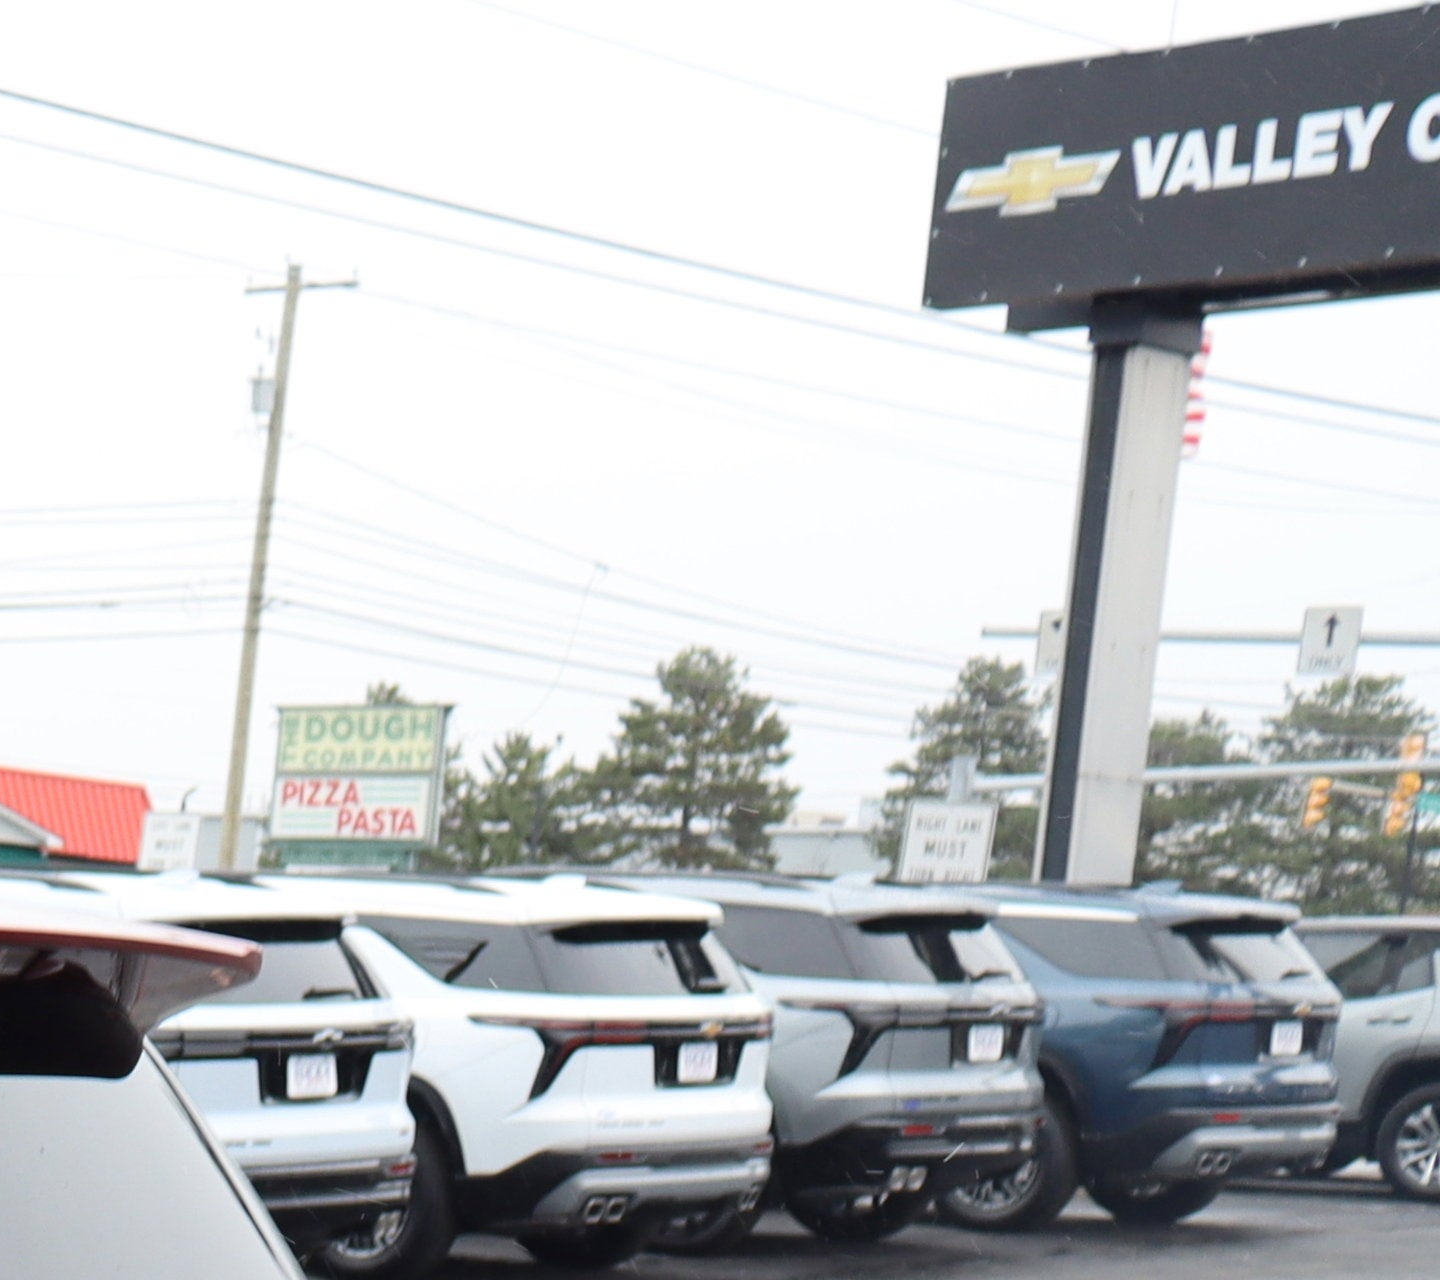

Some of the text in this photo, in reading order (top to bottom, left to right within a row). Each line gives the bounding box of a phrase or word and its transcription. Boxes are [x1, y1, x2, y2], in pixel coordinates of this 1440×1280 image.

[1131, 101, 1394, 200] VALLEY
[305, 714, 433, 743] DOUGH
[304, 748, 432, 768] COMPANY
[282, 779, 361, 807] PIZZA
[336, 807, 417, 836] PASTA
[923, 837, 966, 858] MUST
